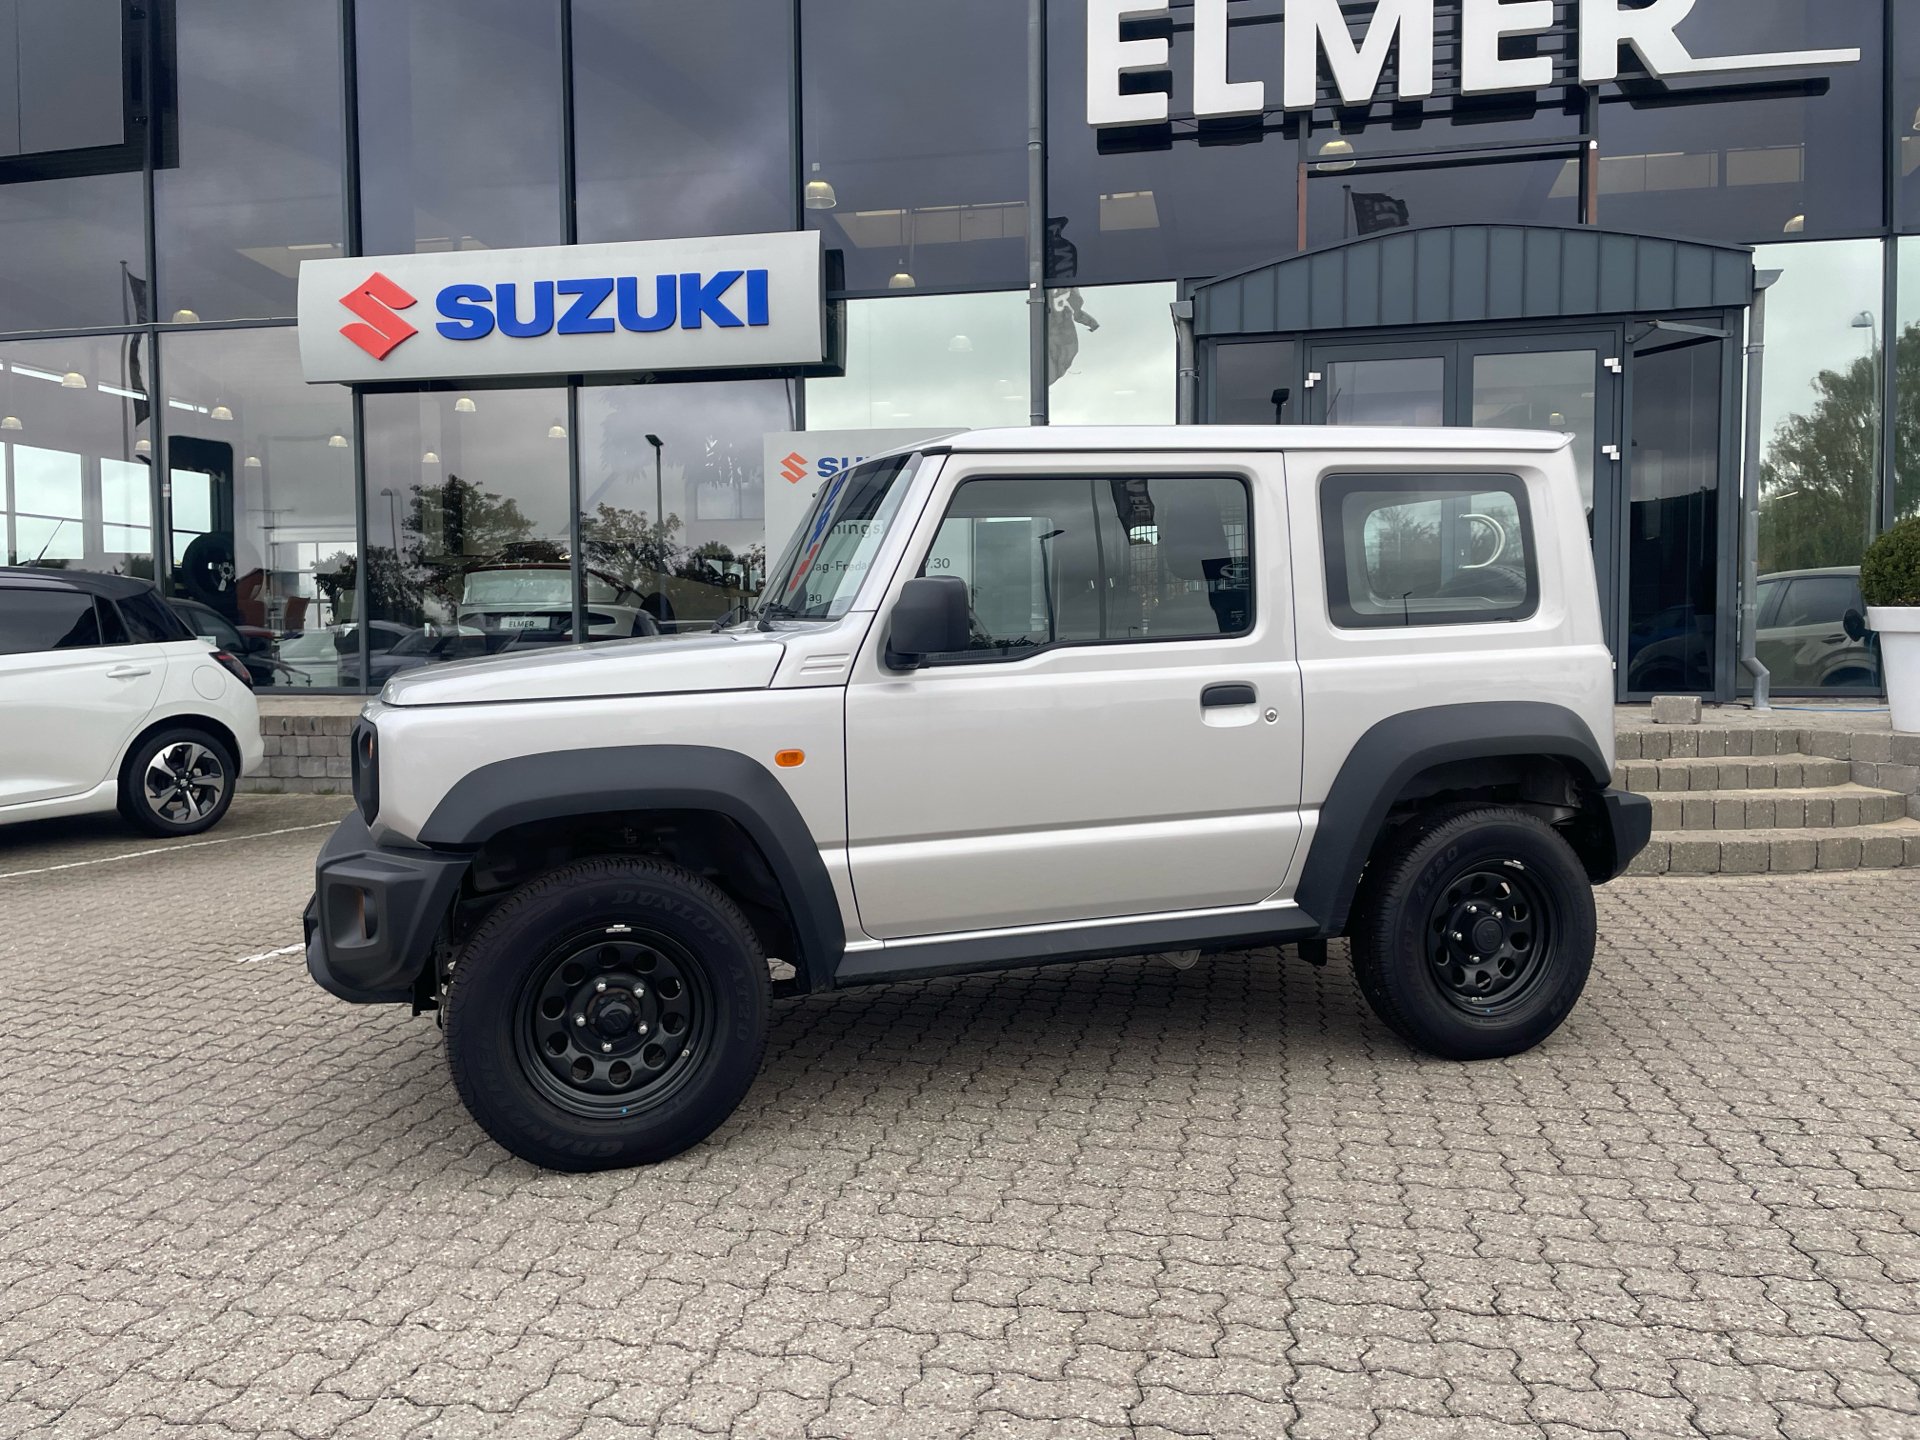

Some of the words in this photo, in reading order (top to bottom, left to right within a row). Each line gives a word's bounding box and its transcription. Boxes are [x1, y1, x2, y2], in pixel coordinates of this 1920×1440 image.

[1087, 0, 1861, 127] ELMER
[435, 269, 768, 341] SUZUKI
[508, 620, 535, 628] ELMER
[611, 889, 729, 945] DUNLOP
[728, 963, 750, 1042] AT20
